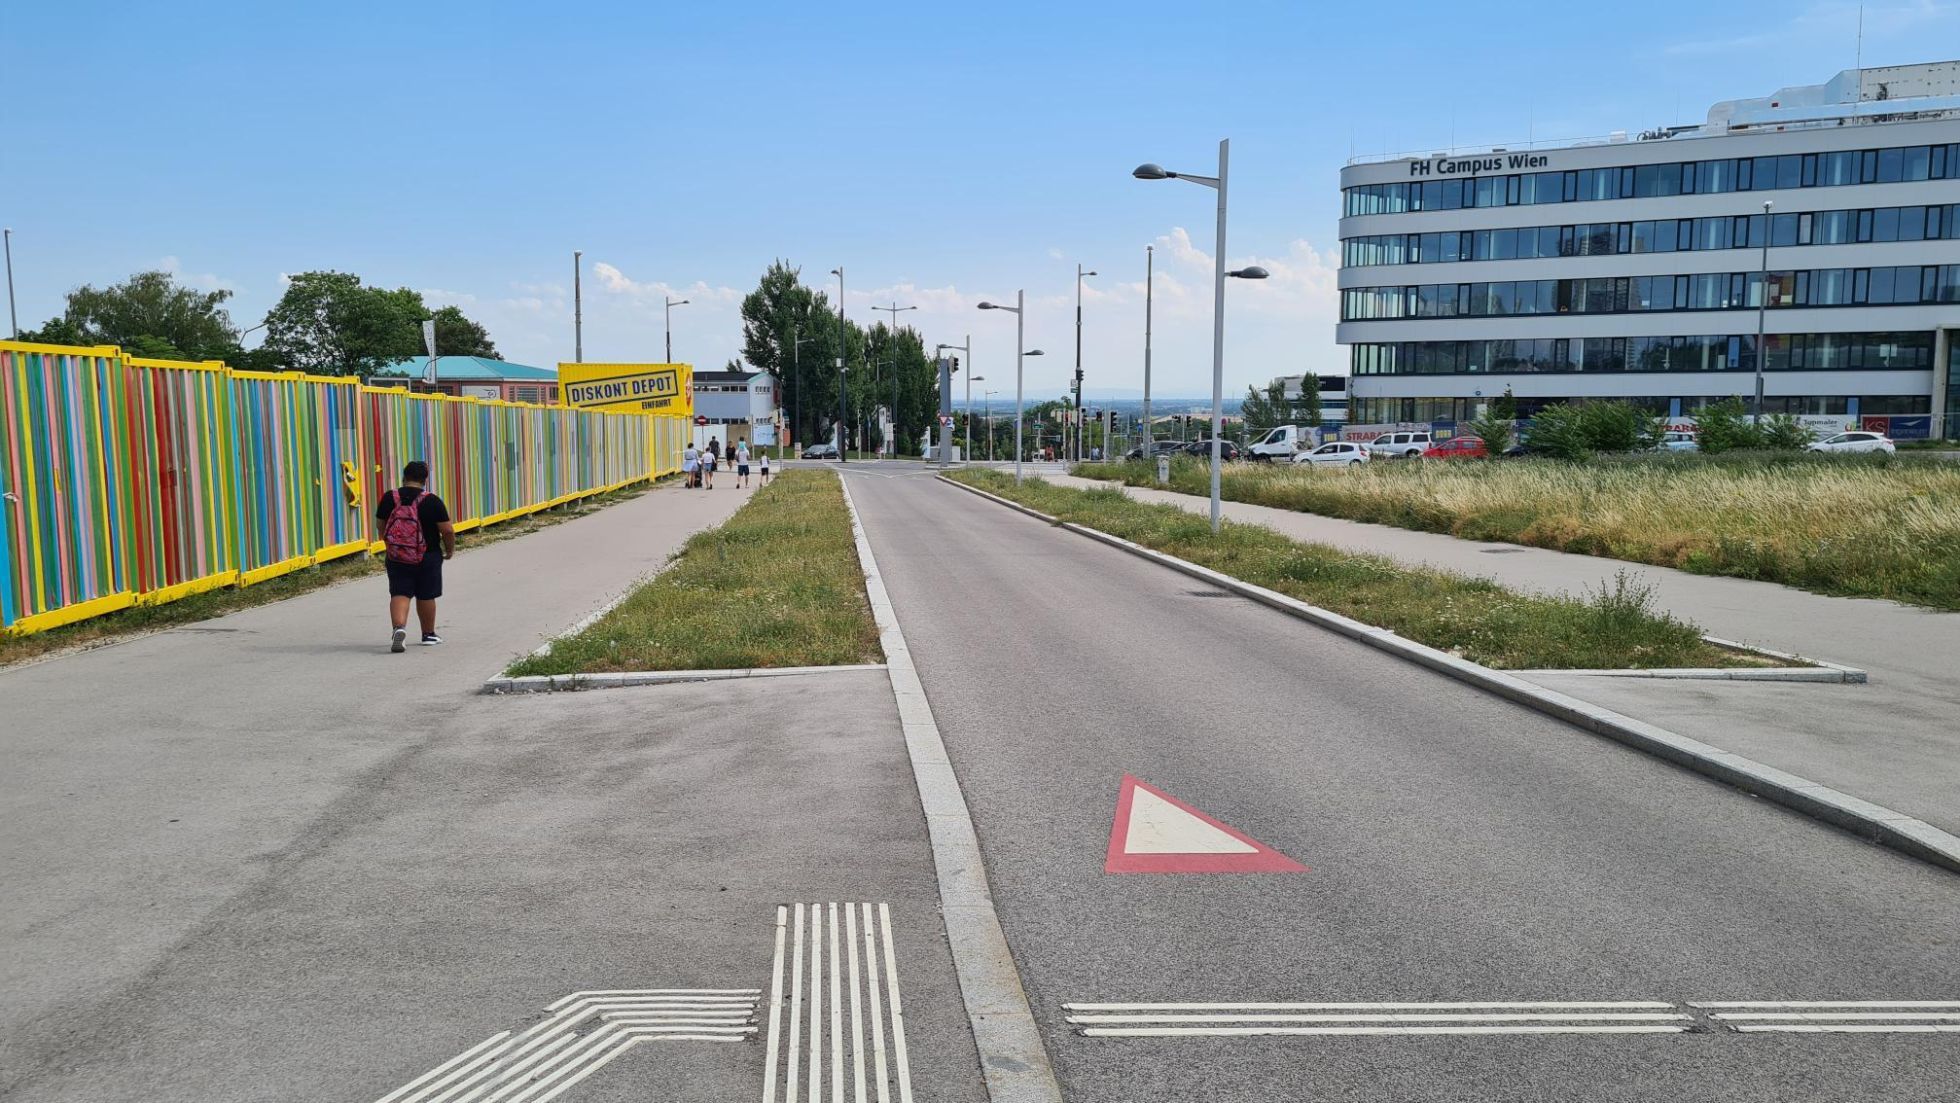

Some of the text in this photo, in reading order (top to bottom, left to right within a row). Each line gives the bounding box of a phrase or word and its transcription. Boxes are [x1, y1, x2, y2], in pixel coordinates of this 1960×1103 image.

[1410, 153, 1548, 176] FH Campus Wien
[571, 382, 629, 403] DISKONT
[632, 376, 672, 395] DEPOT
[1345, 431, 1384, 441] STRABA
